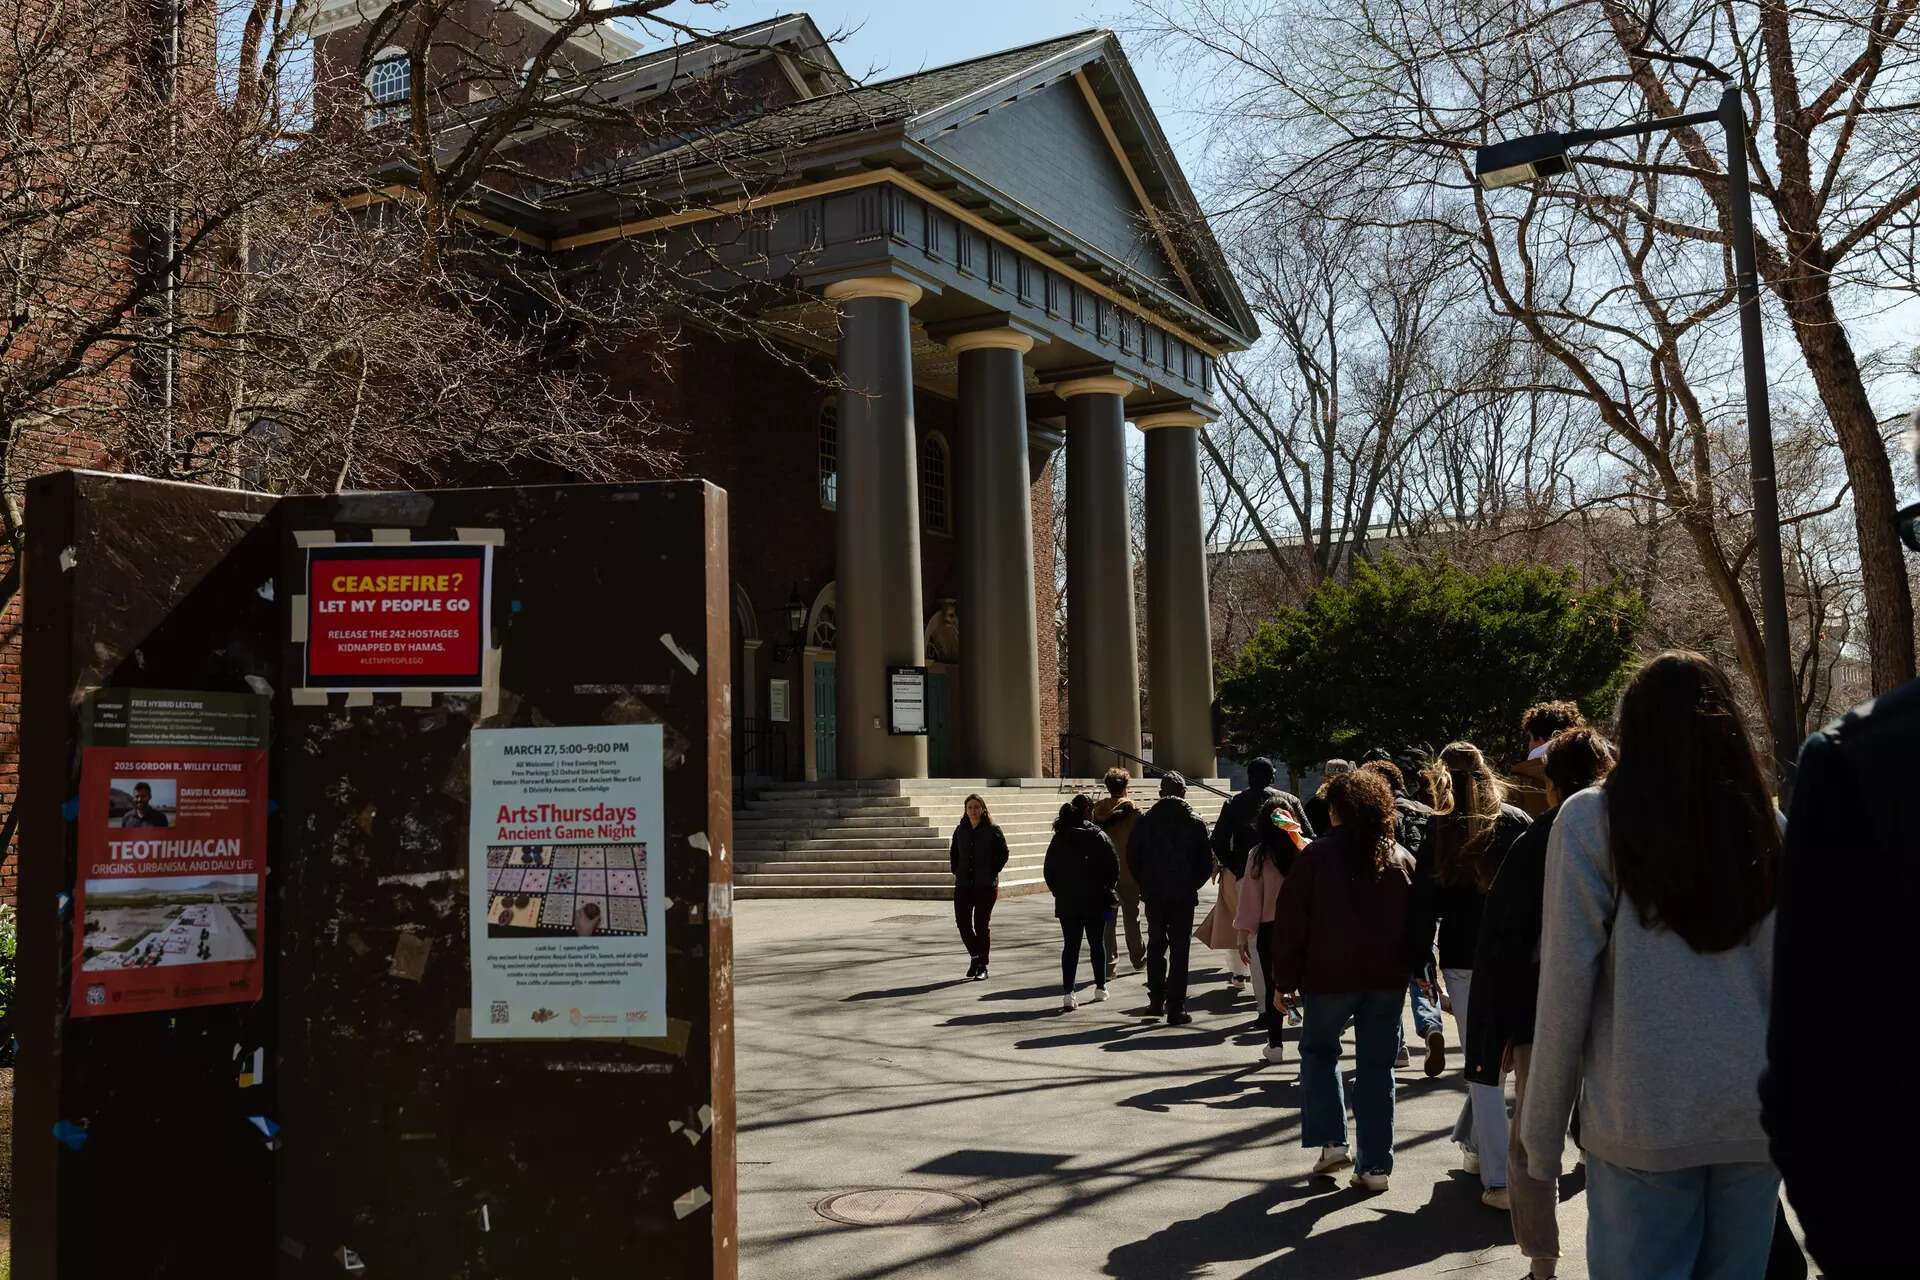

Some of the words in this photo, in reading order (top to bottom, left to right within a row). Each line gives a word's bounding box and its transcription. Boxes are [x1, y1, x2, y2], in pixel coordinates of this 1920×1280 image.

[332, 573, 463, 593] CEASEFIRE?
[319, 600, 347, 613] LET
[351, 600, 376, 613] MY
[381, 599, 442, 612] PEOPLE
[447, 599, 470, 612] GO
[328, 630, 368, 639] RELEASE
[370, 630, 388, 638] THE
[390, 630, 406, 638] 242
[407, 629, 460, 639] HOSTAGES
[338, 643, 391, 653] KIDNAPPED
[393, 643, 407, 652] BY
[408, 643, 446, 652] HAMAS.
[360, 657, 424, 665] #LETMYPEOPLEGO
[131, 699, 148, 708] FREE
[148, 700, 175, 709] HYBRID
[176, 701, 204, 709] LECTURE
[504, 745, 542, 755] MARCH
[544, 744, 558, 755] 27,
[613, 742, 629, 752] PM
[115, 762, 134, 770] 2025
[135, 762, 172, 770] GORDON
[183, 763, 211, 771] WILLEY
[212, 763, 242, 771] LECTURE
[181, 788, 202, 797] DAVID
[212, 788, 247, 797] CARBALLO
[497, 803, 636, 825] ArtsThursdays
[498, 826, 552, 841] Ancient
[555, 825, 595, 840] Game
[598, 823, 636, 842] Night
[109, 839, 240, 860] TEOTIHUACAN
[92, 863, 137, 875] ORIGINS,
[138, 861, 188, 873] URBANISM,
[189, 861, 210, 871] AND
[211, 860, 236, 870] DAILY
[237, 859, 254, 869] LIFE
